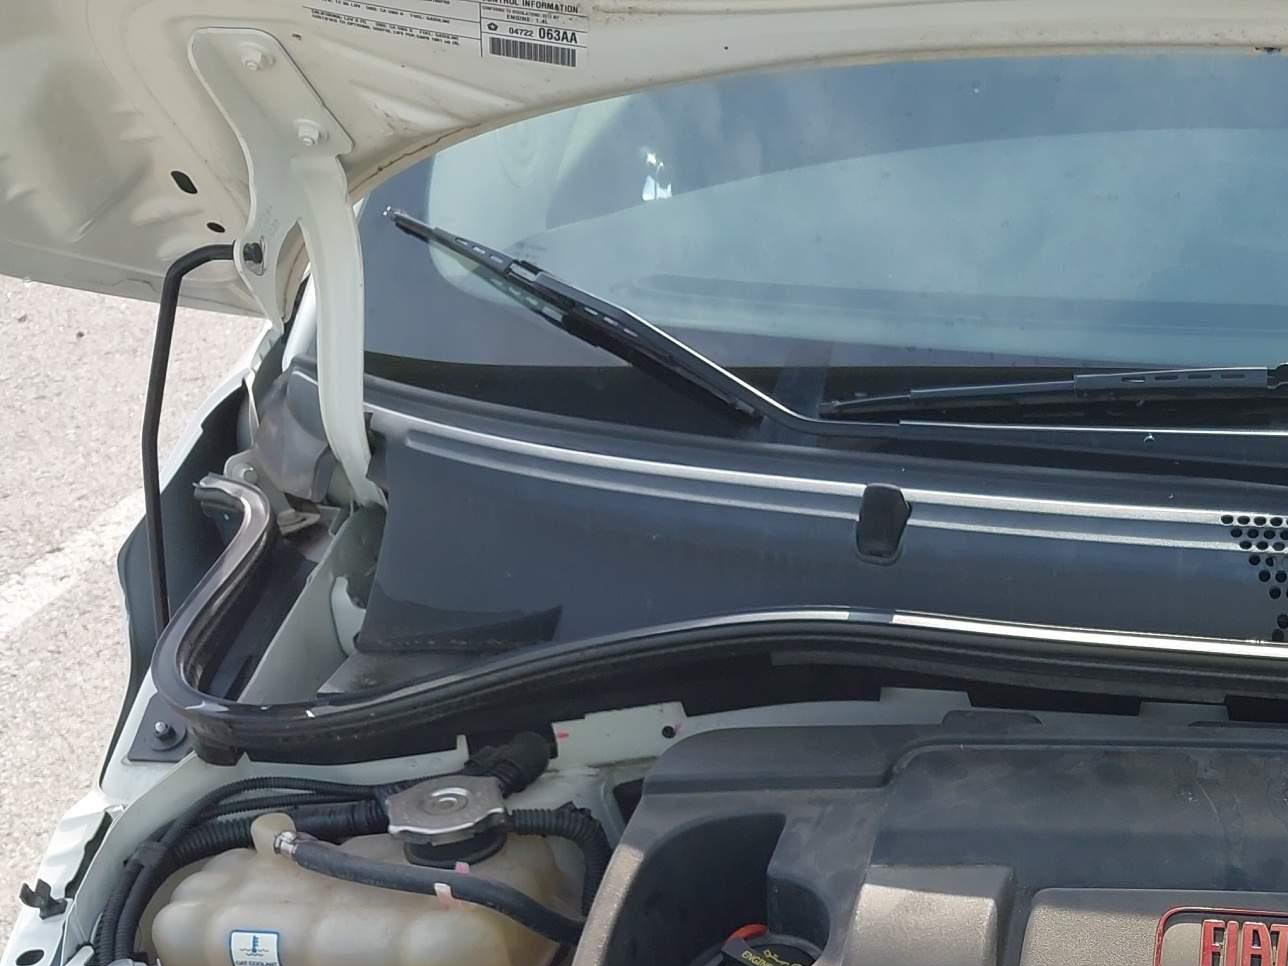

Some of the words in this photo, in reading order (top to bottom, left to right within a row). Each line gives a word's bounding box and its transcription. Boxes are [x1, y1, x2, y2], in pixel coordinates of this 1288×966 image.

[522, 0, 578, 13] INFORMATION
[508, 27, 534, 37] 04722
[538, 28, 578, 44] 063AA
